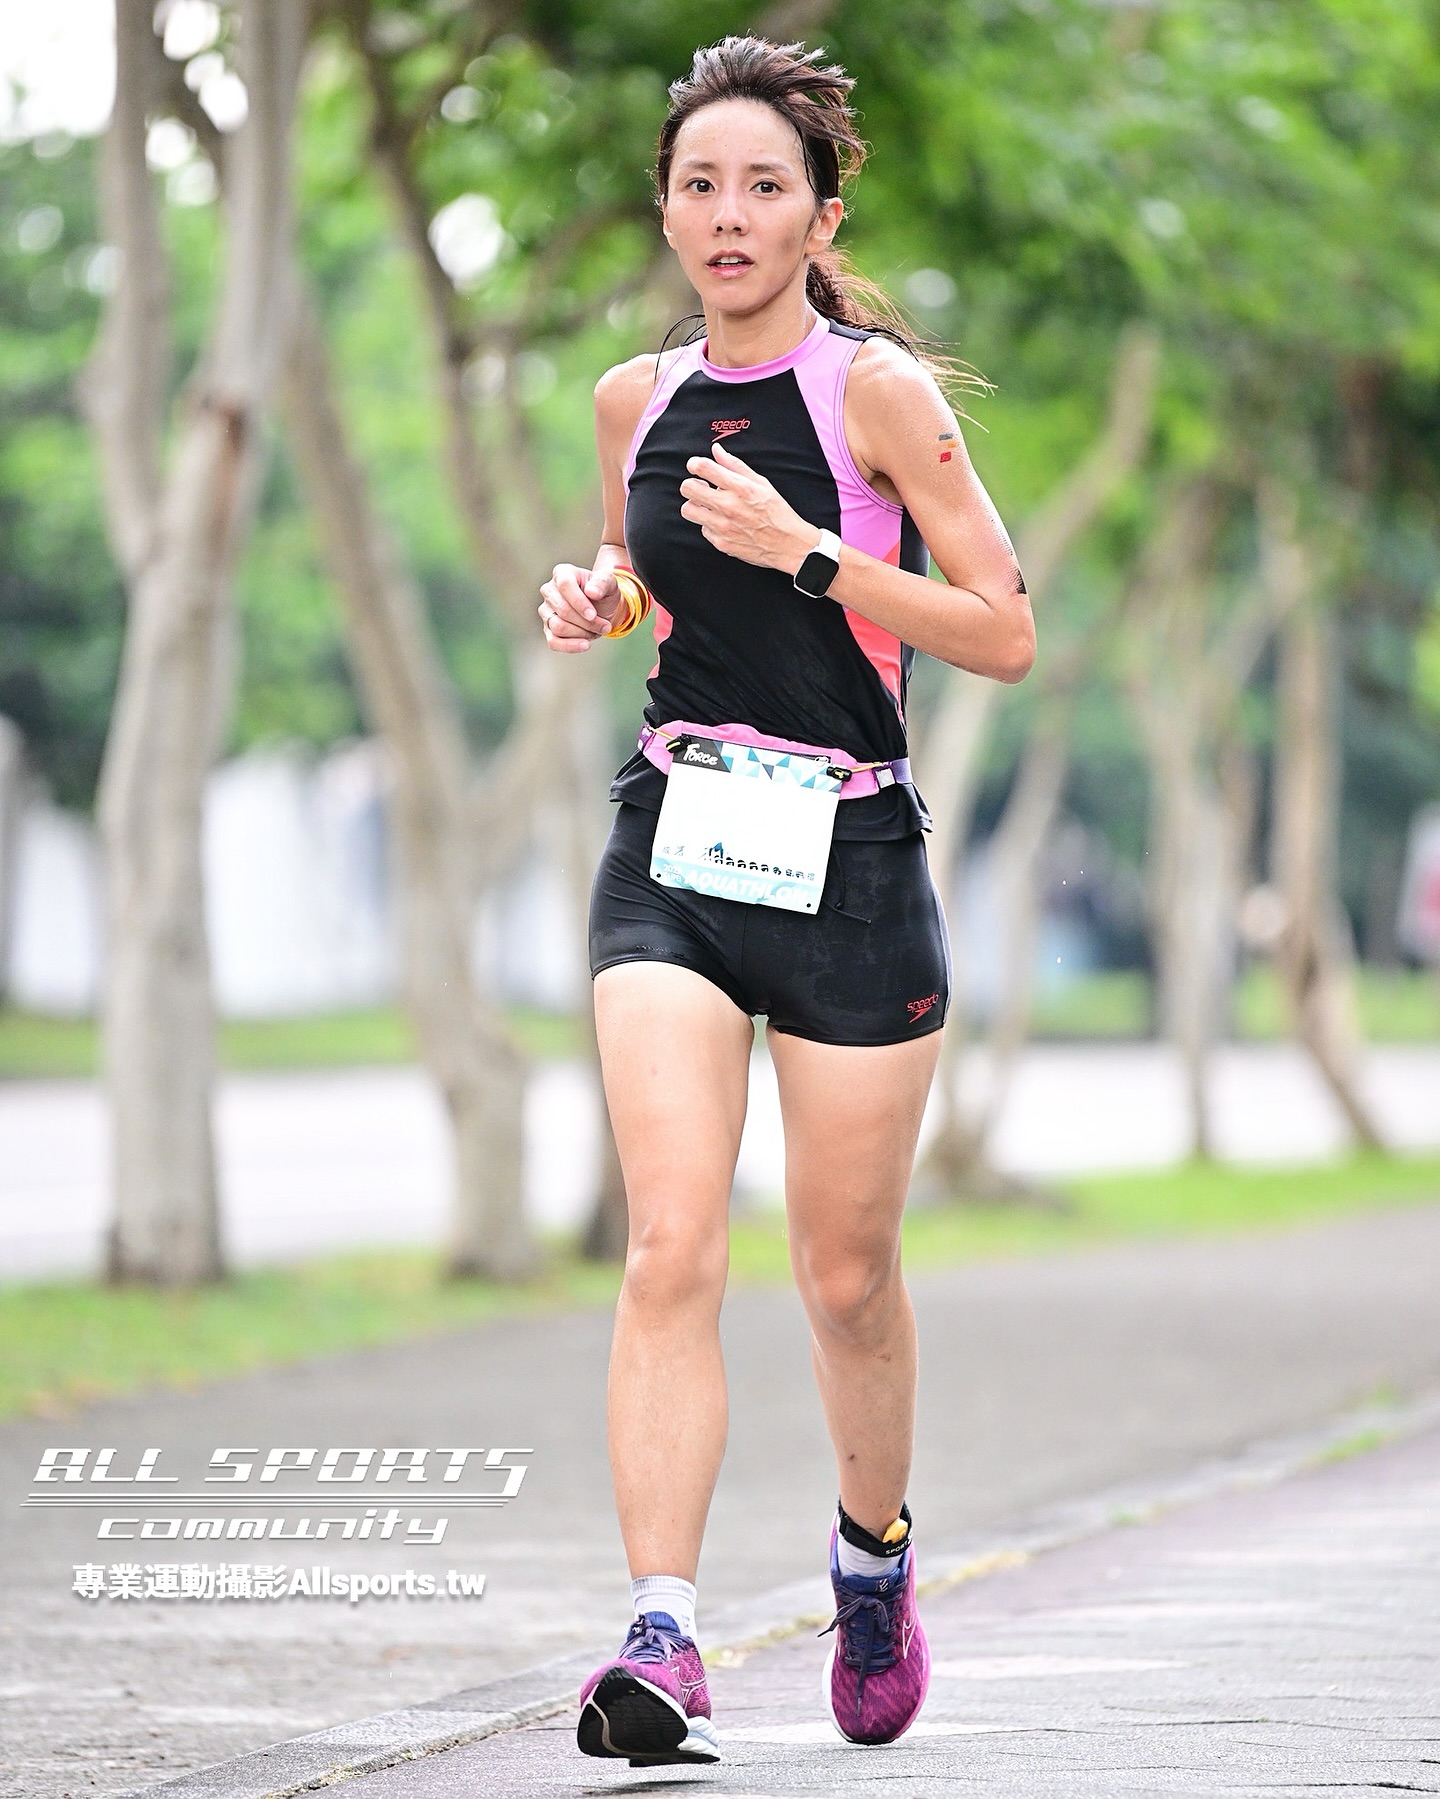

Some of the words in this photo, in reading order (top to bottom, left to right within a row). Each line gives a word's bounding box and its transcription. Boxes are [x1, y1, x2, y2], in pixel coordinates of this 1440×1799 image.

[711, 418, 750, 432] speedo
[685, 870, 810, 904] AQUATHLON
[907, 993, 939, 1013] speedo
